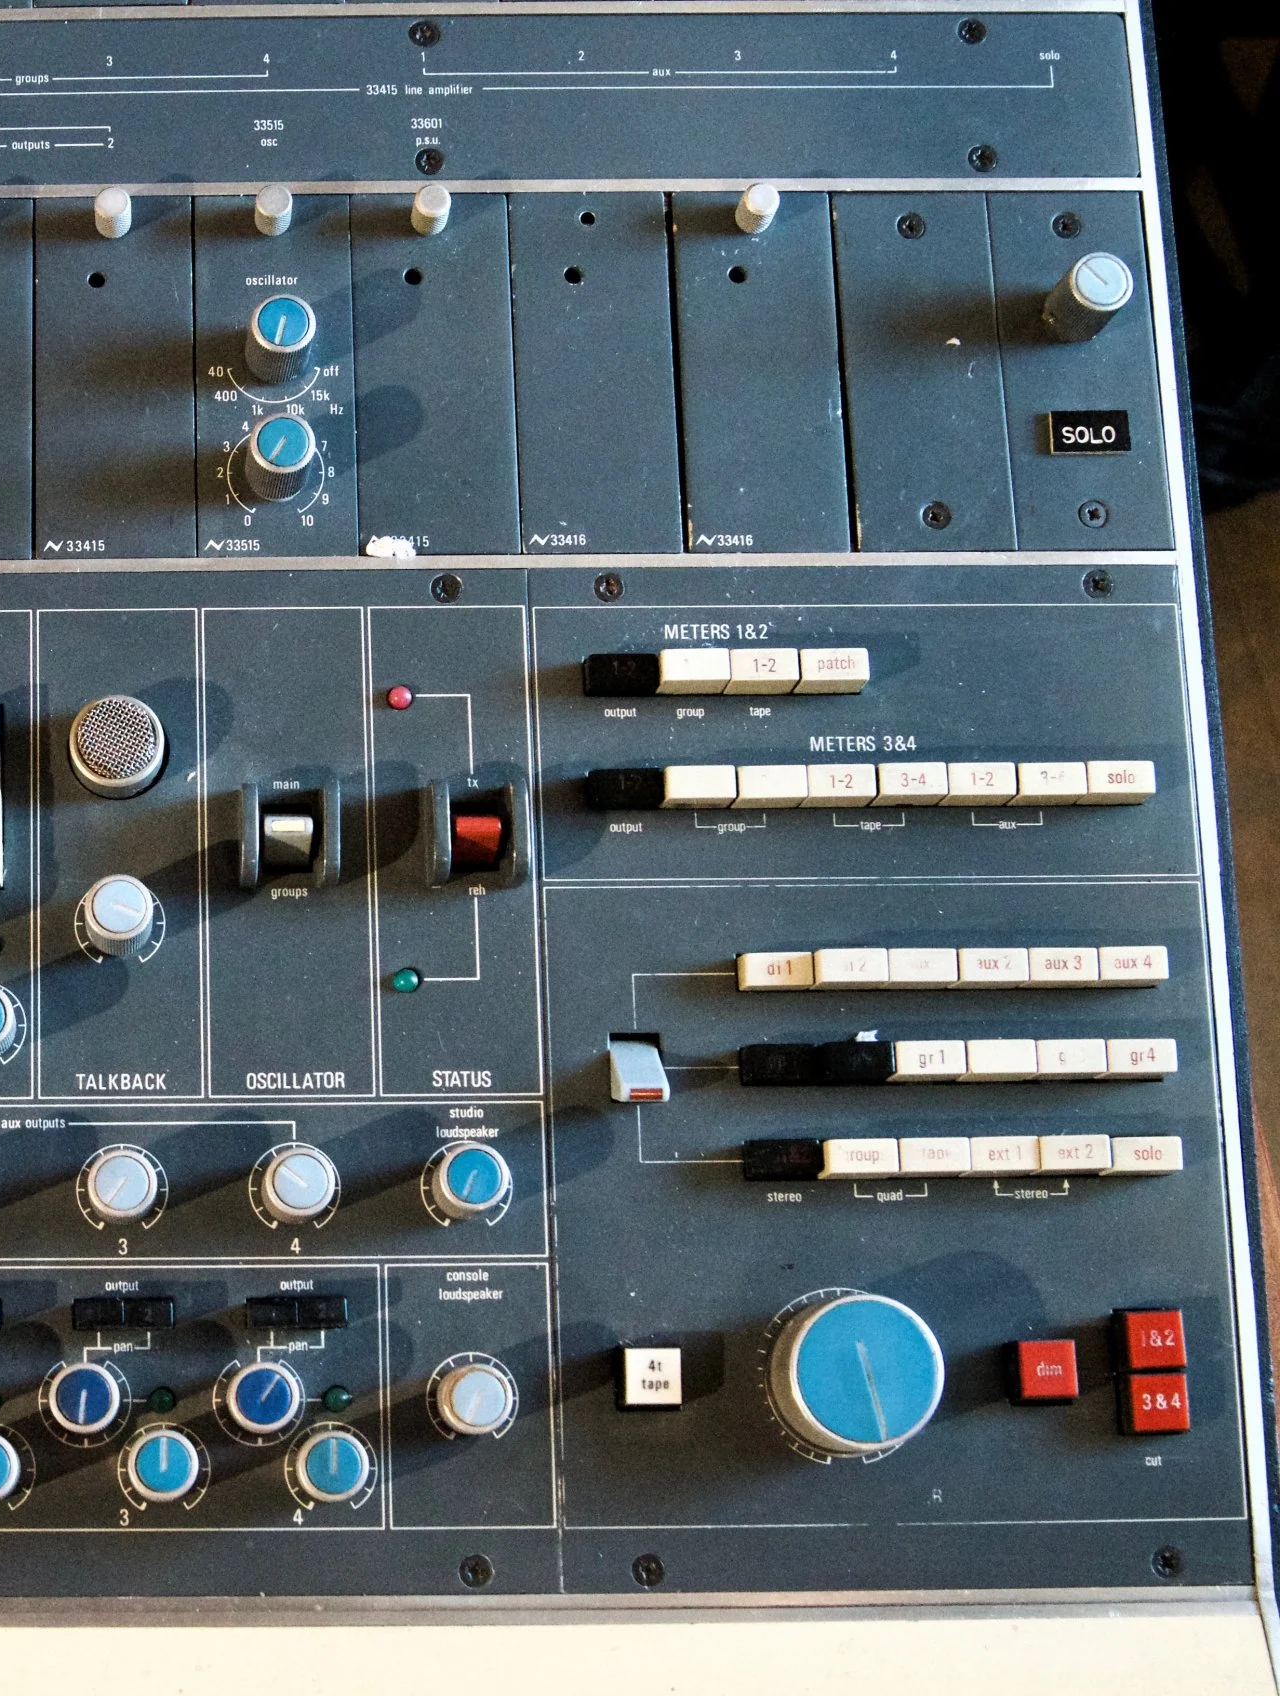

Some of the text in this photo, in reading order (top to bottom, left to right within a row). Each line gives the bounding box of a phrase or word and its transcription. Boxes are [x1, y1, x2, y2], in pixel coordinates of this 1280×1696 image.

[106, 55, 113, 67] 3
[262, 53, 270, 64] 4
[734, 50, 742, 61] 3
[890, 49, 897, 60] 4
[1039, 50, 1060, 61] solo
[15, 72, 50, 85] groups
[652, 67, 671, 77] aux
[365, 82, 473, 97] 33415 line amplifier
[253, 119, 284, 131] 33515
[410, 118, 442, 129] 33601
[11, 138, 51, 151] outputs
[260, 137, 278, 147] osc
[245, 275, 298, 286] oscillator
[207, 366, 224, 378] 40
[323, 365, 340, 377] off
[214, 390, 238, 402] 400
[311, 389, 331, 401] 15k
[252, 404, 263, 416] 1k
[286, 403, 305, 416] 10k
[330, 403, 344, 415] Hz
[241, 421, 249, 432] 4
[1061, 425, 1116, 445] SOLO
[327, 466, 335, 478] 8
[321, 493, 329, 505] 9
[301, 514, 314, 526] 10
[66, 539, 105, 552] 33415
[226, 539, 260, 551] 33515
[390, 536, 430, 548] 415
[550, 534, 587, 546] 33416
[717, 534, 753, 546] 33416
[664, 624, 768, 640] METERS 1&2
[753, 659, 776, 673] 1-2
[817, 656, 856, 670] patch
[604, 706, 637, 718] output
[676, 706, 705, 719] group
[749, 706, 771, 718] tape
[810, 736, 917, 752] METERS 3&4
[273, 778, 300, 789] main
[467, 777, 479, 788] tx
[829, 774, 853, 789] 1-2
[900, 773, 926, 787] 3-4
[970, 772, 993, 786] 1-2
[1107, 770, 1136, 784] solo
[609, 822, 643, 833] output
[717, 822, 746, 833] group
[860, 820, 882, 832] tape
[998, 819, 1017, 830] aux
[270, 885, 308, 899] groups
[468, 884, 486, 896] reh
[1044, 955, 1082, 971] aux 3
[1114, 954, 1153, 970] aux 4
[1146, 1048, 1155, 1062] 4
[75, 1073, 167, 1091] TALKBACK
[246, 1072, 345, 1090] OSCILLATOR
[432, 1070, 492, 1088] STATUS
[449, 1106, 484, 1119] studio
[0, 1117, 66, 1131] aux outputs
[435, 1125, 499, 1140] loudspeaker
[1133, 1147, 1162, 1161] solo
[767, 1191, 802, 1202] stereo
[876, 1189, 903, 1204] quad
[1014, 1188, 1048, 1199] stereo
[118, 1238, 128, 1256] 3
[290, 1238, 301, 1255] 4
[446, 1270, 489, 1282] console
[105, 1279, 139, 1293] output
[280, 1279, 314, 1293] output
[438, 1288, 503, 1302] loudspeaker
[113, 1340, 134, 1353] pan
[288, 1339, 309, 1353] pan
[648, 1359, 663, 1373] 4t
[640, 1376, 670, 1393] tape
[1145, 1454, 1163, 1467] cut
[119, 1509, 130, 1526] 3
[292, 1509, 304, 1525] 4
